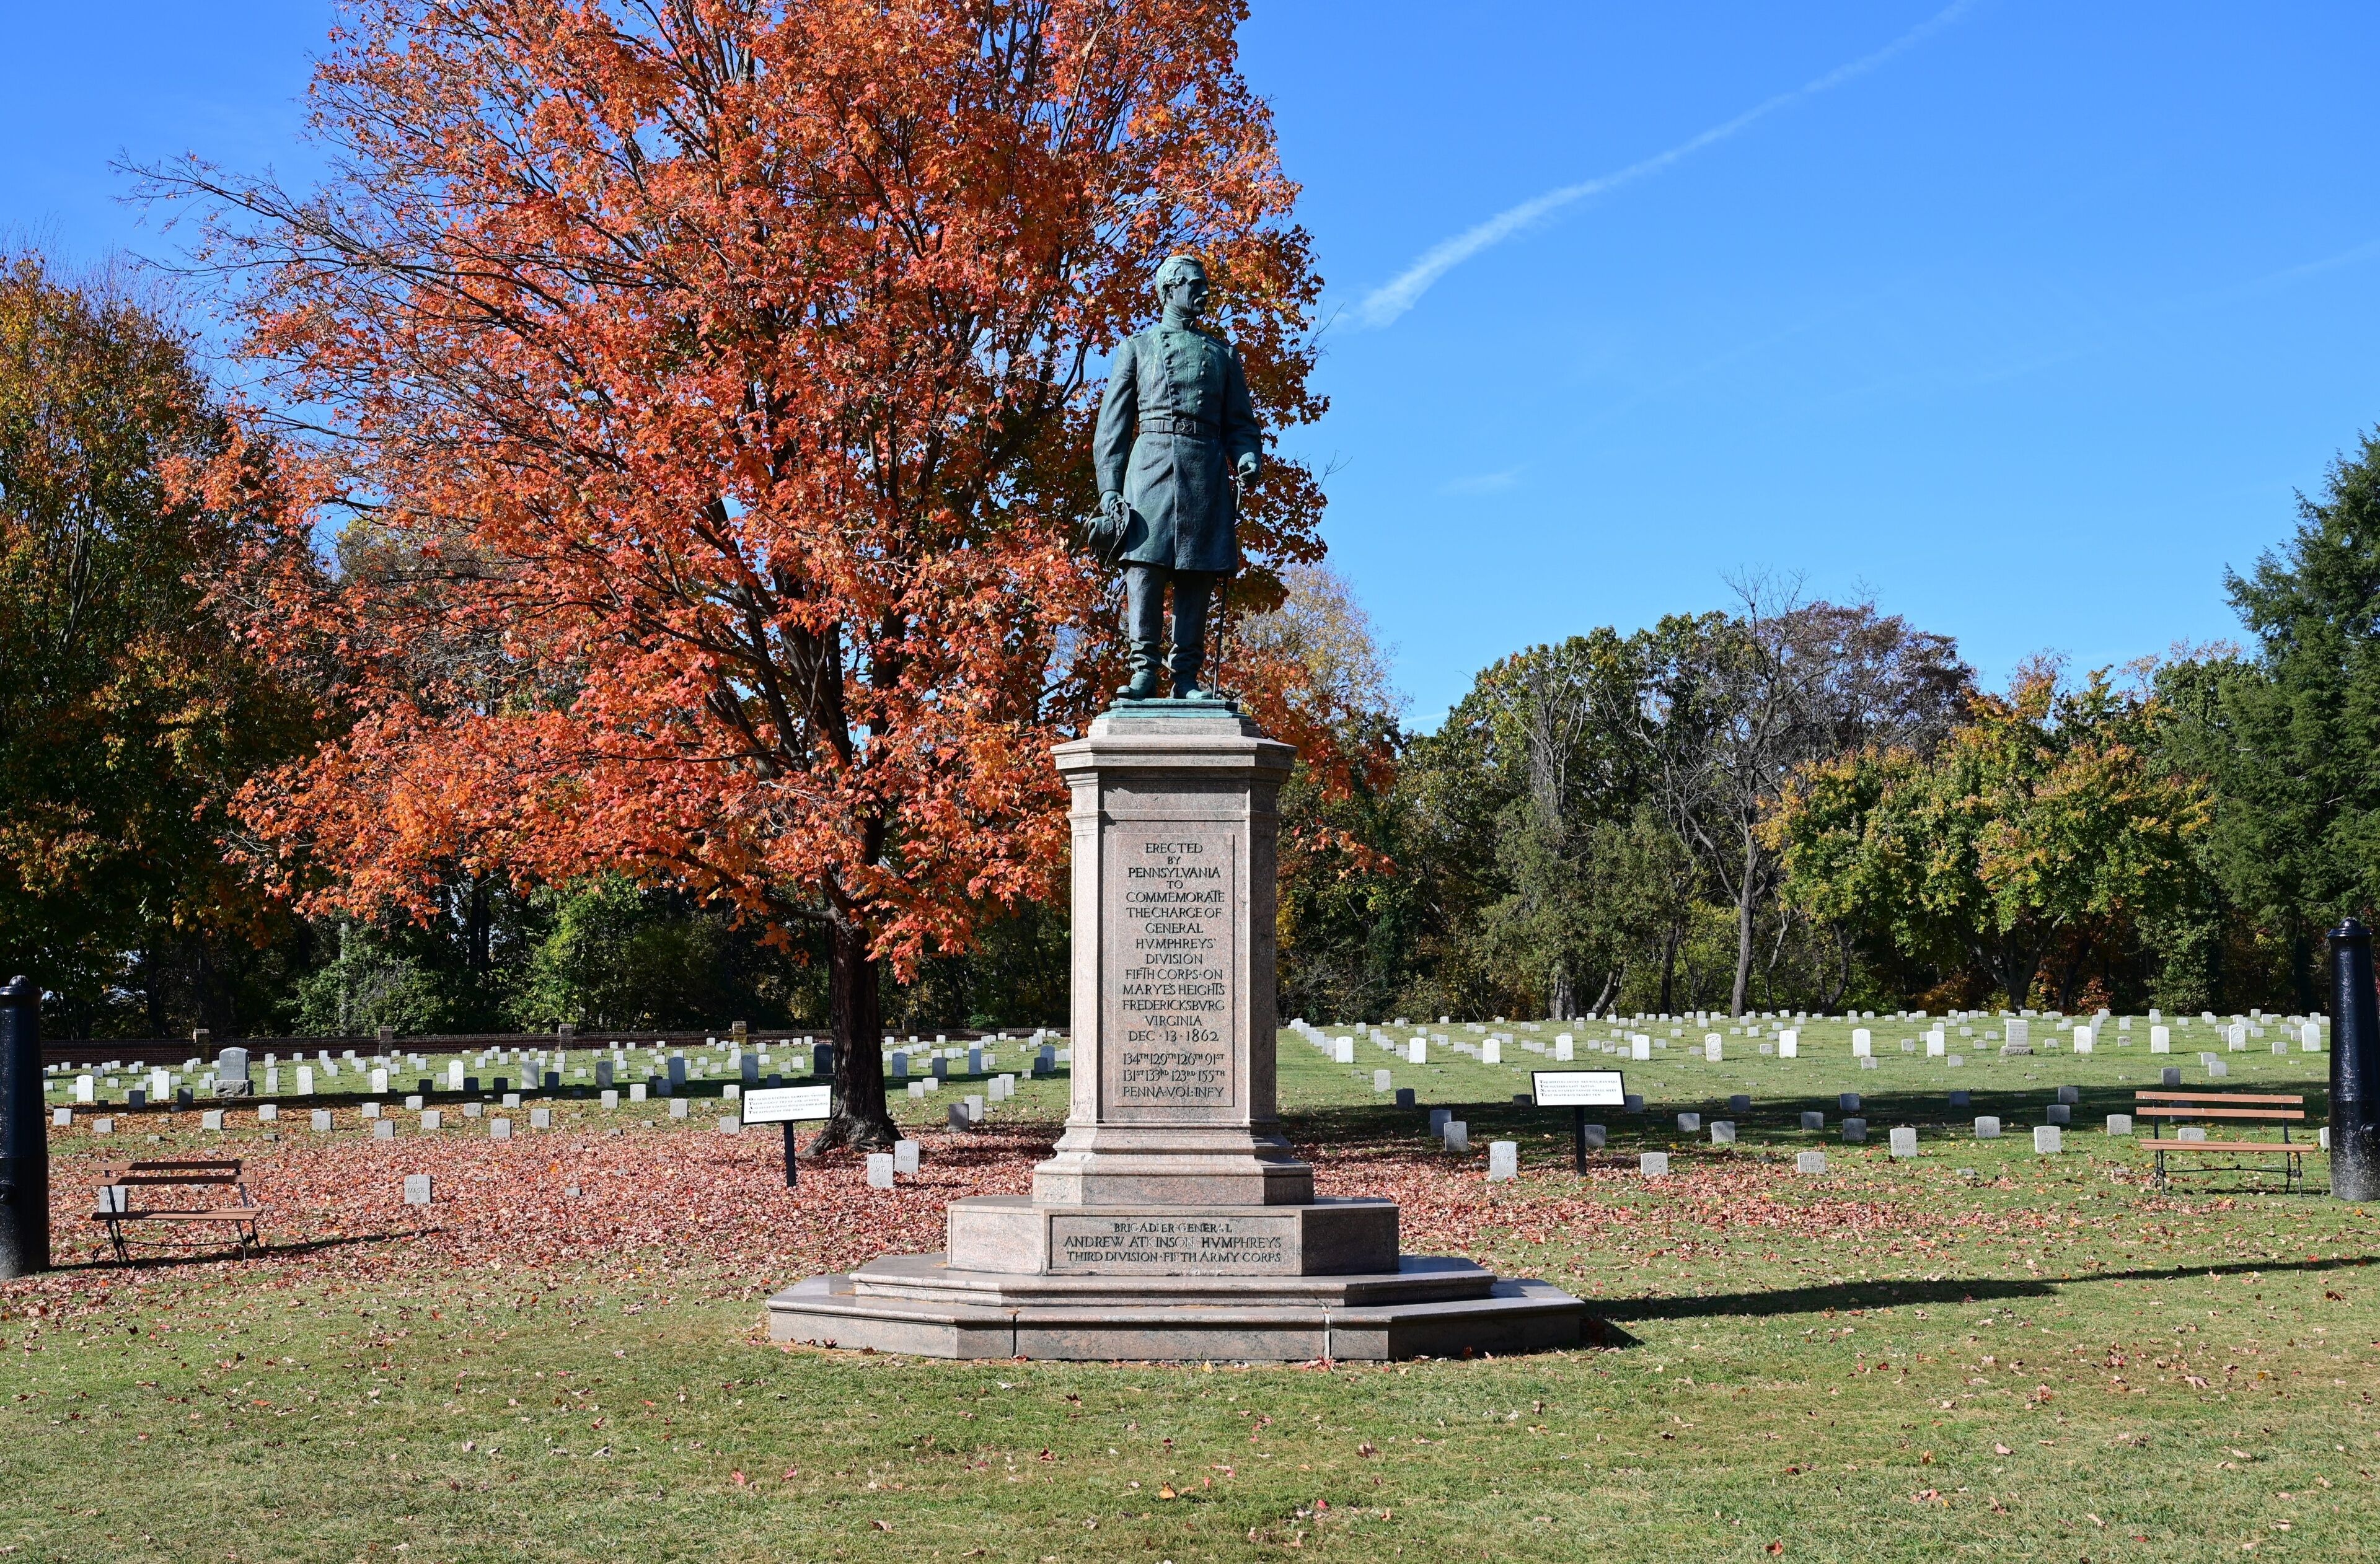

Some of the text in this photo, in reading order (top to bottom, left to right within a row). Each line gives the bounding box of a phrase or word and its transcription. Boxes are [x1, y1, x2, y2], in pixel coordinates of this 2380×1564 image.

[1146, 843, 1203, 853] ERECTED
[1168, 856, 1181, 864] BY
[1128, 868, 1221, 878] PENNSYLVANIA
[1166, 881, 1183, 889] TO
[1126, 890, 1225, 902] COMMEMORATE
[1126, 907, 1222, 918] THE CHARGE OF
[1146, 923, 1204, 933] GENERAL
[1146, 954, 1203, 965] DIVISION
[1125, 967, 1155, 980] FIFTH
[1179, 983, 1225, 995] HEIGHTS
[1145, 1016, 1202, 1026] VIRGINIA
[1129, 1029, 1220, 1042] DEC 13 1862
[1123, 1053, 1148, 1065] 134TH
[1150, 1053, 1176, 1065] 129TH
[1205, 1053, 1225, 1065] 91ST
[1172, 1070, 1196, 1082] 123RD
[1198, 1070, 1225, 1082] 155TH
[1114, 1223, 1233, 1233] BRIGADIER GENERAL
[1063, 1236, 1124, 1248] ANDREW
[1129, 1236, 1194, 1248] ATKINSON
[1067, 1251, 1281, 1262] THIRD DIVISION FIFTH ARMY CORPS
